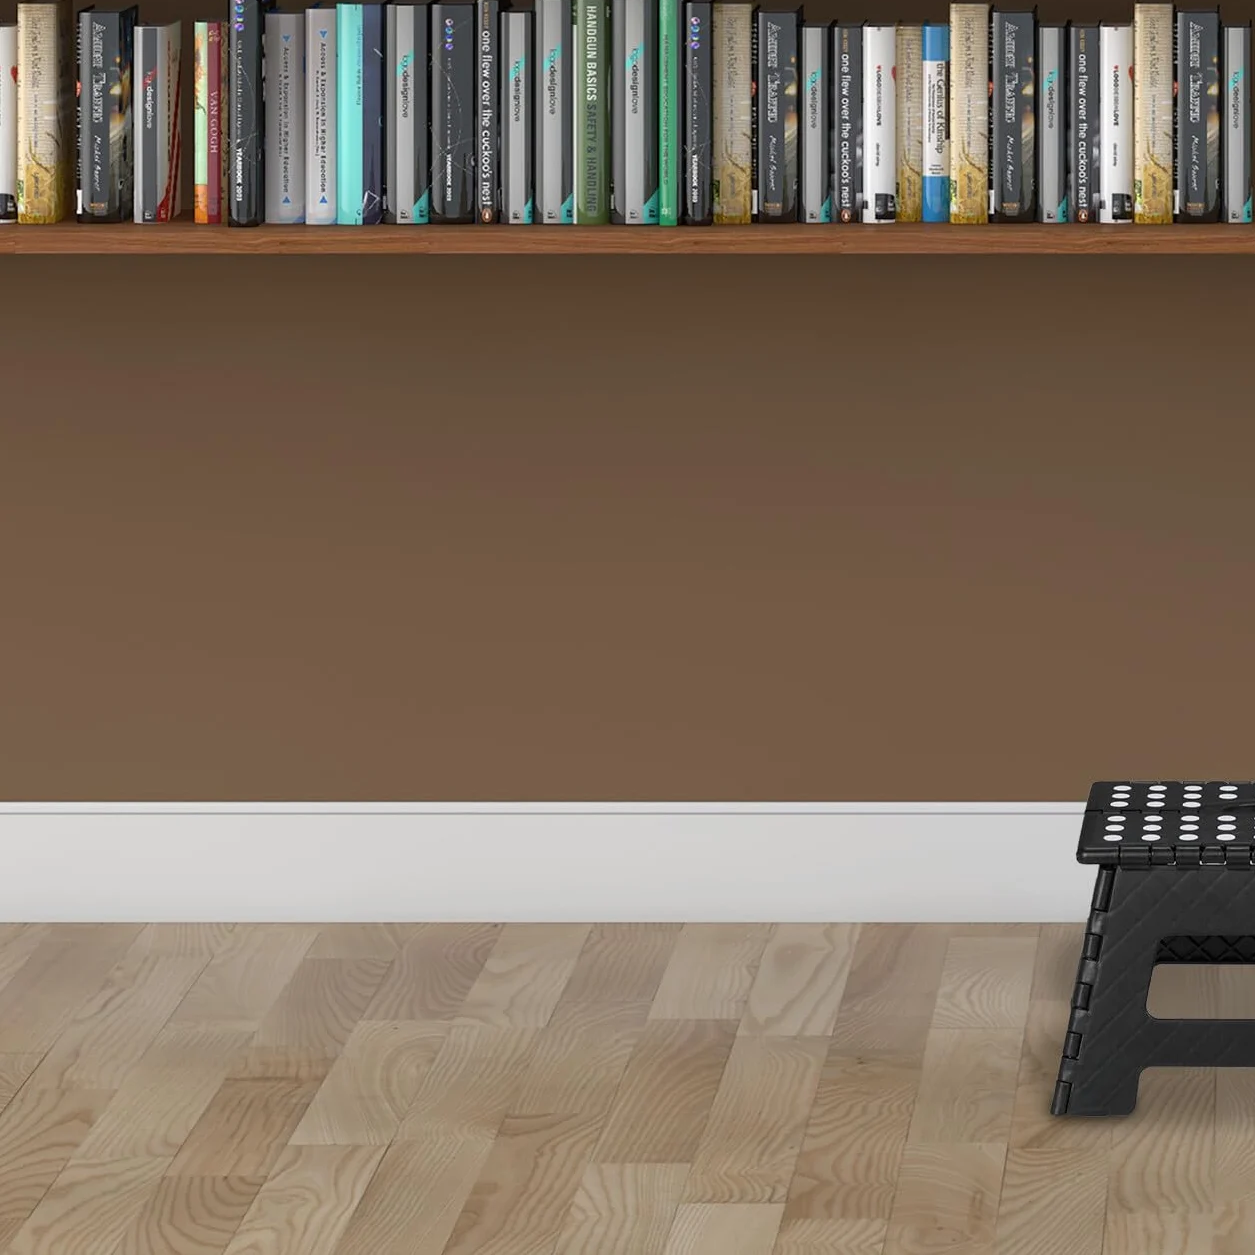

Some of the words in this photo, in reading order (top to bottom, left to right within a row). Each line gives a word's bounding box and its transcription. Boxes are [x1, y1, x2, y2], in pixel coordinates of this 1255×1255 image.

[482, 30, 490, 52] one
[586, 6, 597, 58] HANDGUN
[481, 55, 493, 78] flew
[936, 63, 945, 77] the
[481, 80, 490, 106] over
[586, 62, 597, 101] BASICS
[936, 79, 945, 107] Genius
[1078, 75, 1088, 96] flew
[210, 91, 218, 115] VAN
[936, 110, 945, 120] of
[1078, 98, 1086, 120] over
[482, 109, 492, 127] the
[587, 103, 598, 143] SAFETY
[210, 118, 218, 153] GOGH
[934, 122, 945, 153] Kinship
[1079, 123, 1088, 139] the
[482, 130, 492, 178] cuckoo's
[1078, 141, 1088, 184] cuckoo's
[482, 182, 492, 205] nest
[586, 157, 598, 213] HANDLING
[1079, 186, 1088, 207] nest
